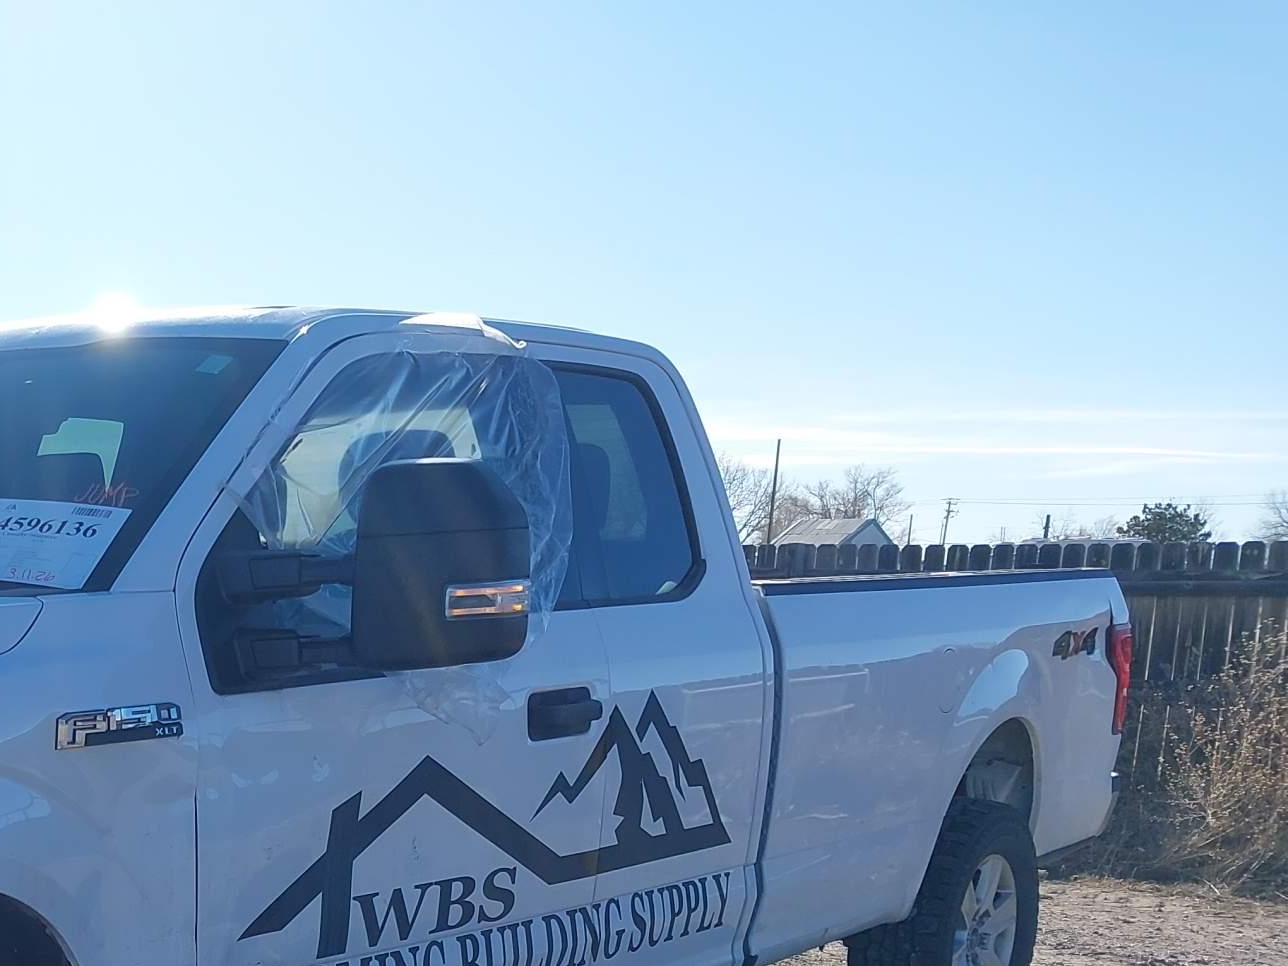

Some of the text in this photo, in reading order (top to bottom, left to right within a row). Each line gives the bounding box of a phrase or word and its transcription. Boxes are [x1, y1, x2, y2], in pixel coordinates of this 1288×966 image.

[73, 481, 140, 507] JUMP
[155, 726, 179, 737] XLT
[352, 867, 518, 948] WBS
[628, 872, 732, 952] SUPPLY
